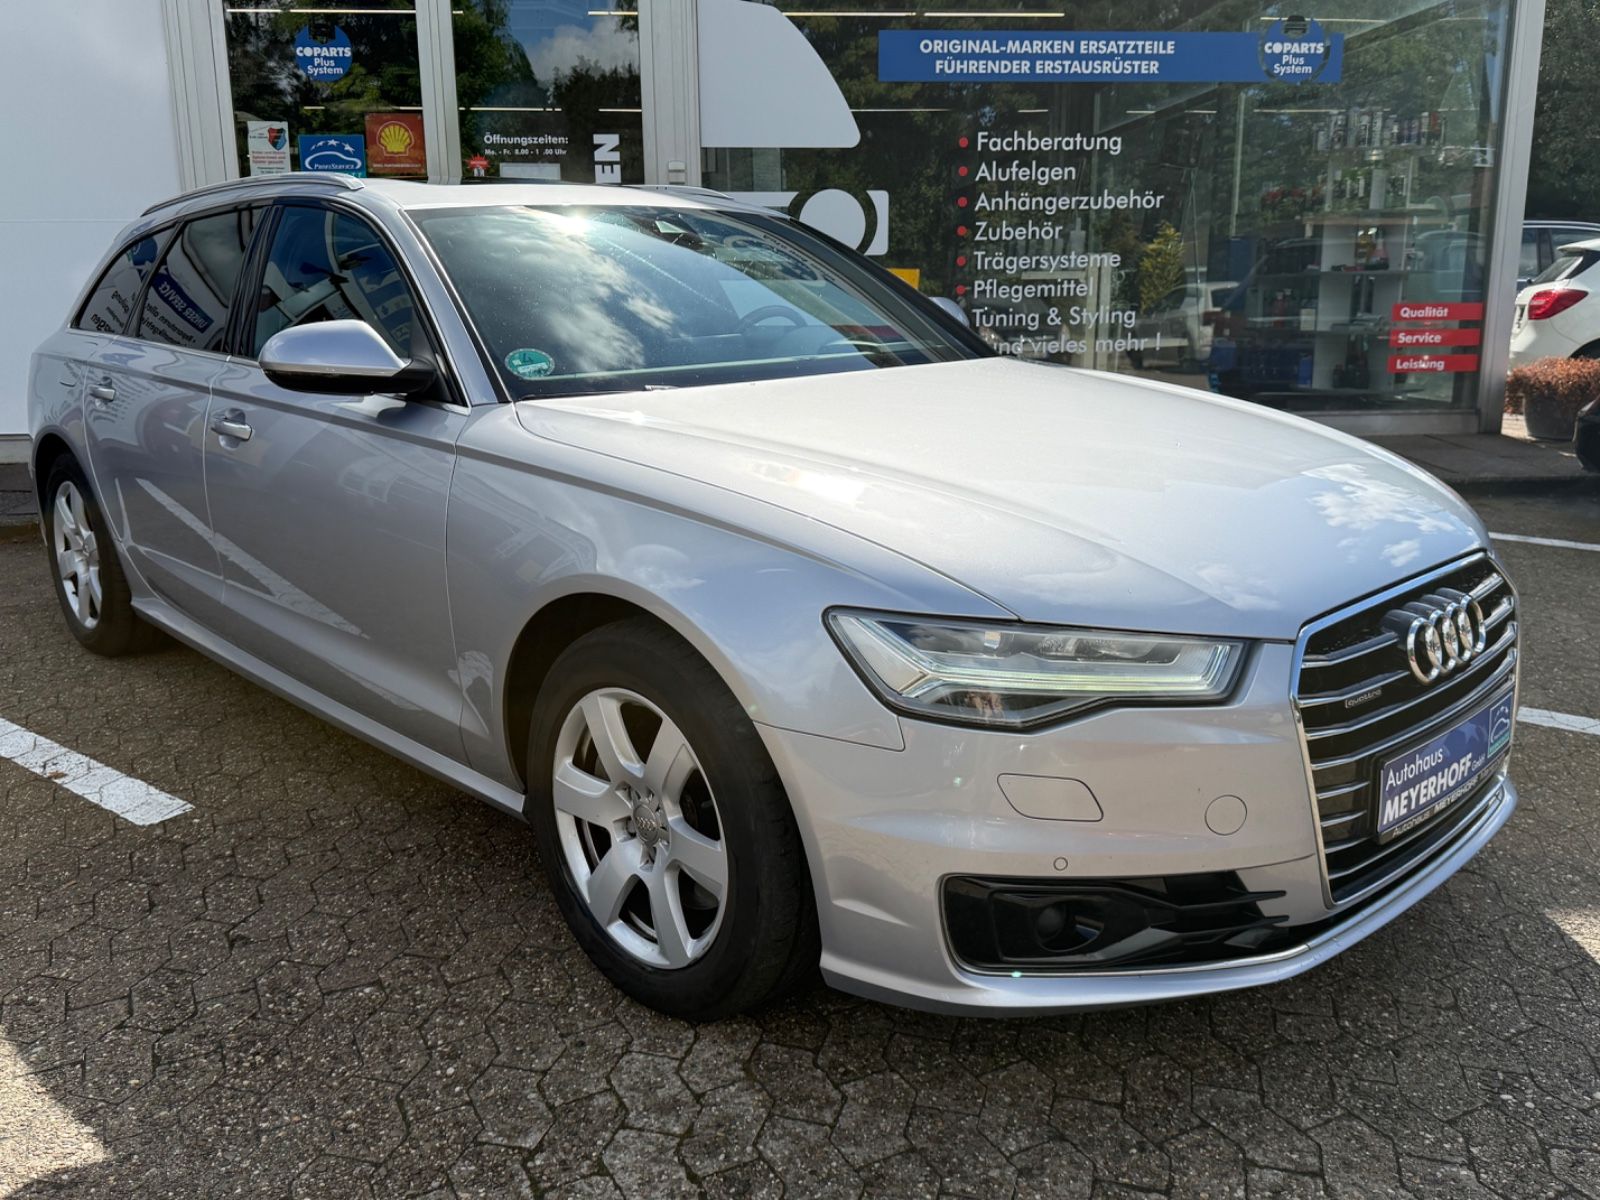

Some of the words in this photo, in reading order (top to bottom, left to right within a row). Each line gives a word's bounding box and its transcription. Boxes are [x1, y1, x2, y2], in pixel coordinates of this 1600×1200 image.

[295, 46, 352, 57] COPARTS
[919, 39, 1075, 54] ORIGINAL-MARKEN
[1079, 40, 1176, 55] ERSATZTEILE
[1263, 42, 1325, 54] COPARTS
[314, 57, 335, 66] Plus
[935, 57, 1030, 74] FÜHRENDER
[1035, 57, 1160, 74] ERSTAUSRÜSTER
[1282, 54, 1305, 65] Plus
[307, 65, 343, 76] System
[1273, 63, 1313, 76] System
[483, 132, 569, 146] Öffnungszeiten:
[976, 130, 1122, 155] Fachberatung
[484, 148, 498, 156] Mo.
[554, 148, 568, 156] Uhr
[975, 160, 1077, 186] Alufelgen
[974, 188, 1165, 215] Anhängerzubehör
[974, 219, 1064, 241] Zubehör
[973, 251, 1122, 274] Trägersysteme
[973, 276, 1094, 302] Pflegemittel
[972, 308, 1040, 331] Tuning
[1047, 307, 1063, 326] &
[1069, 305, 1137, 329] Styling
[1400, 305, 1449, 318] Qualität
[1031, 333, 1087, 354] vieles
[1095, 332, 1149, 353] mehr
[1155, 331, 1161, 350] !
[1397, 331, 1442, 344] Service
[1396, 359, 1445, 372] Leistung
[1385, 748, 1444, 792] Autohaus
[1382, 752, 1473, 826] MEYERHOFF
